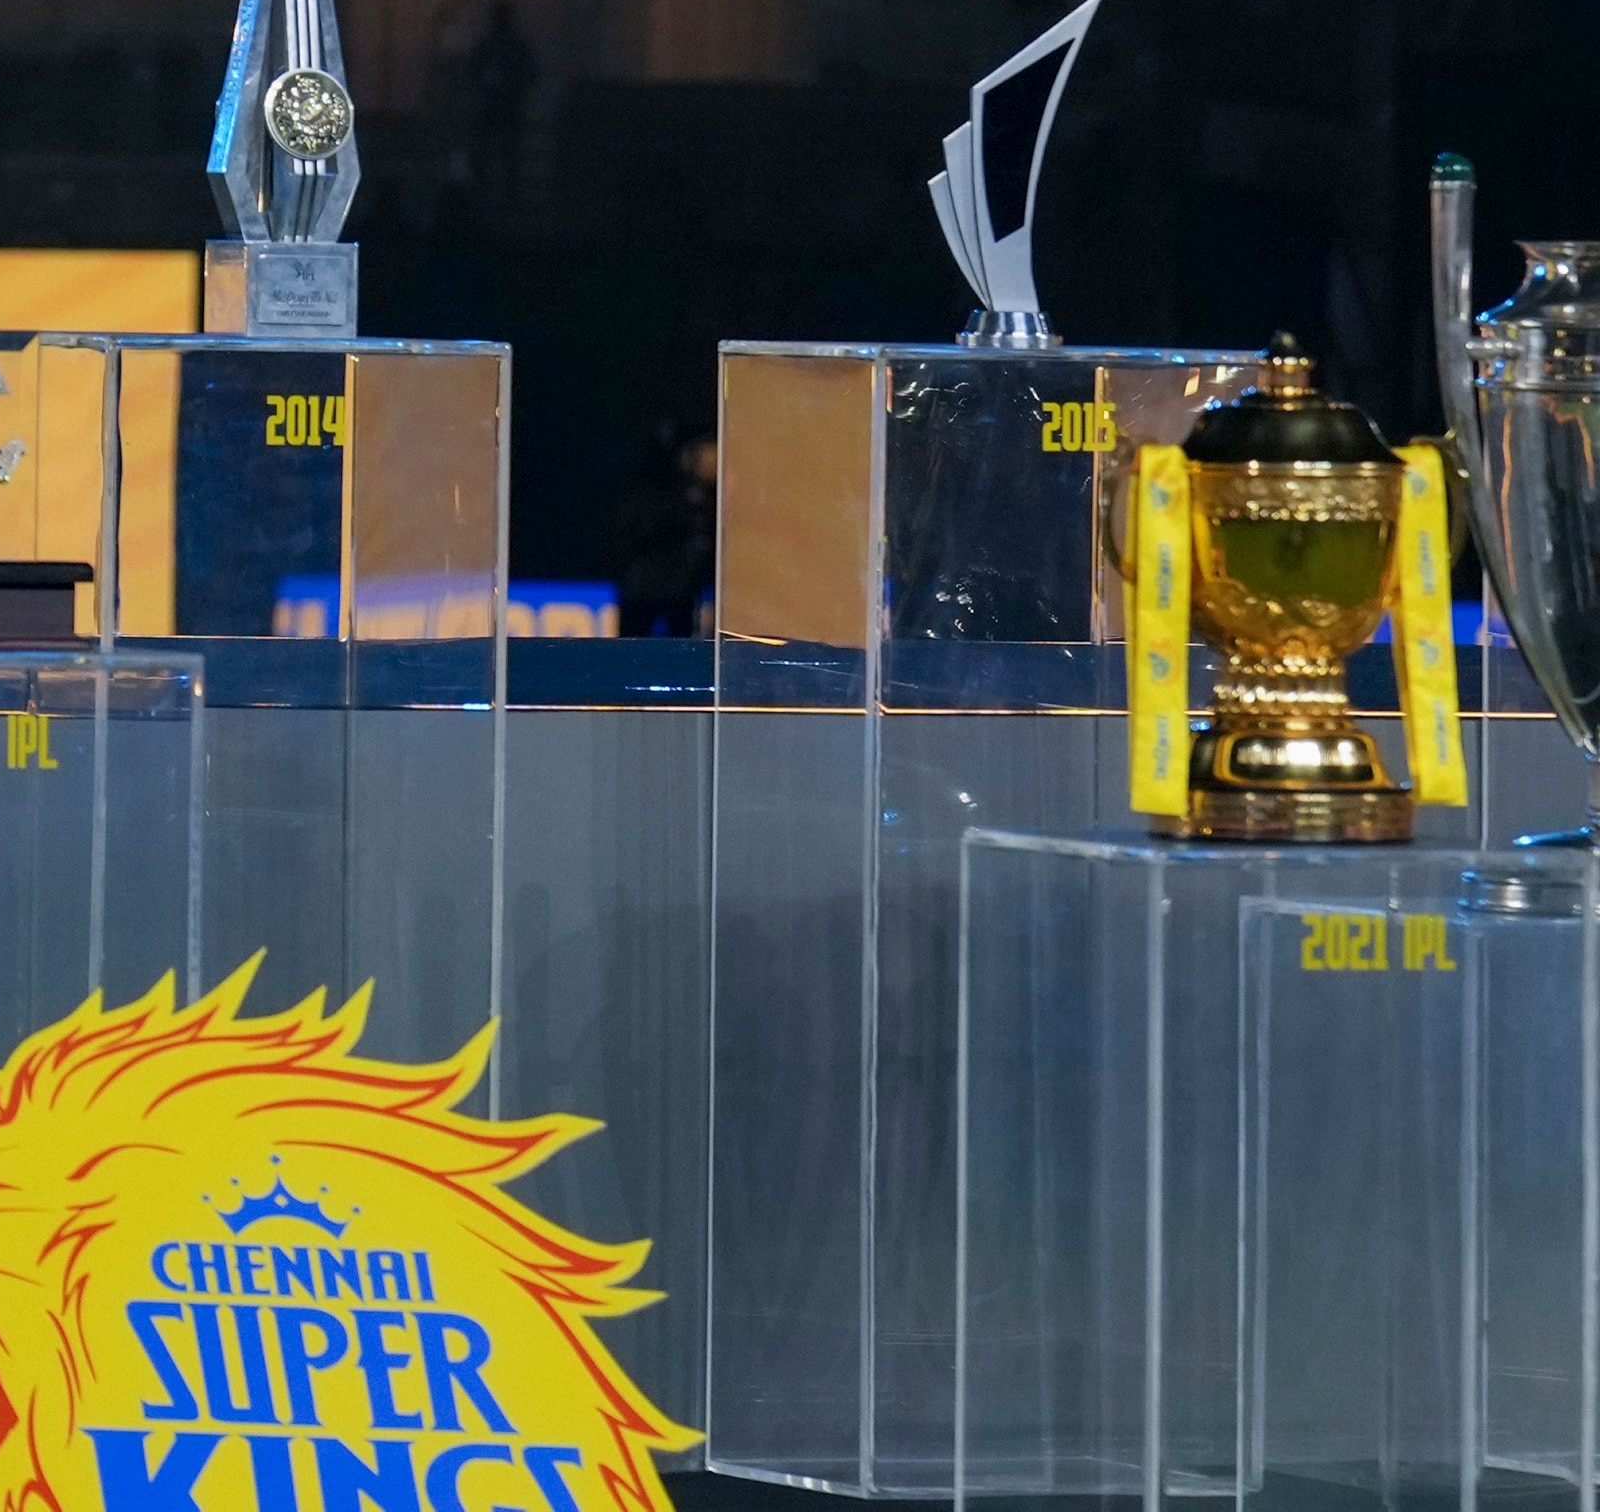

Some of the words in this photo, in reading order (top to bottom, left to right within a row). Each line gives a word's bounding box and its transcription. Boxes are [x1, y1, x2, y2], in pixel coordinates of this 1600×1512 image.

[266, 395, 345, 446] 2014
[1042, 401, 1117, 452] 2015
[7, 714, 58, 769] IPL
[1301, 913, 1388, 972] 2021
[1403, 913, 1457, 972] IPL
[151, 1241, 435, 1304] CHENNAI
[126, 1300, 517, 1435] SUPER
